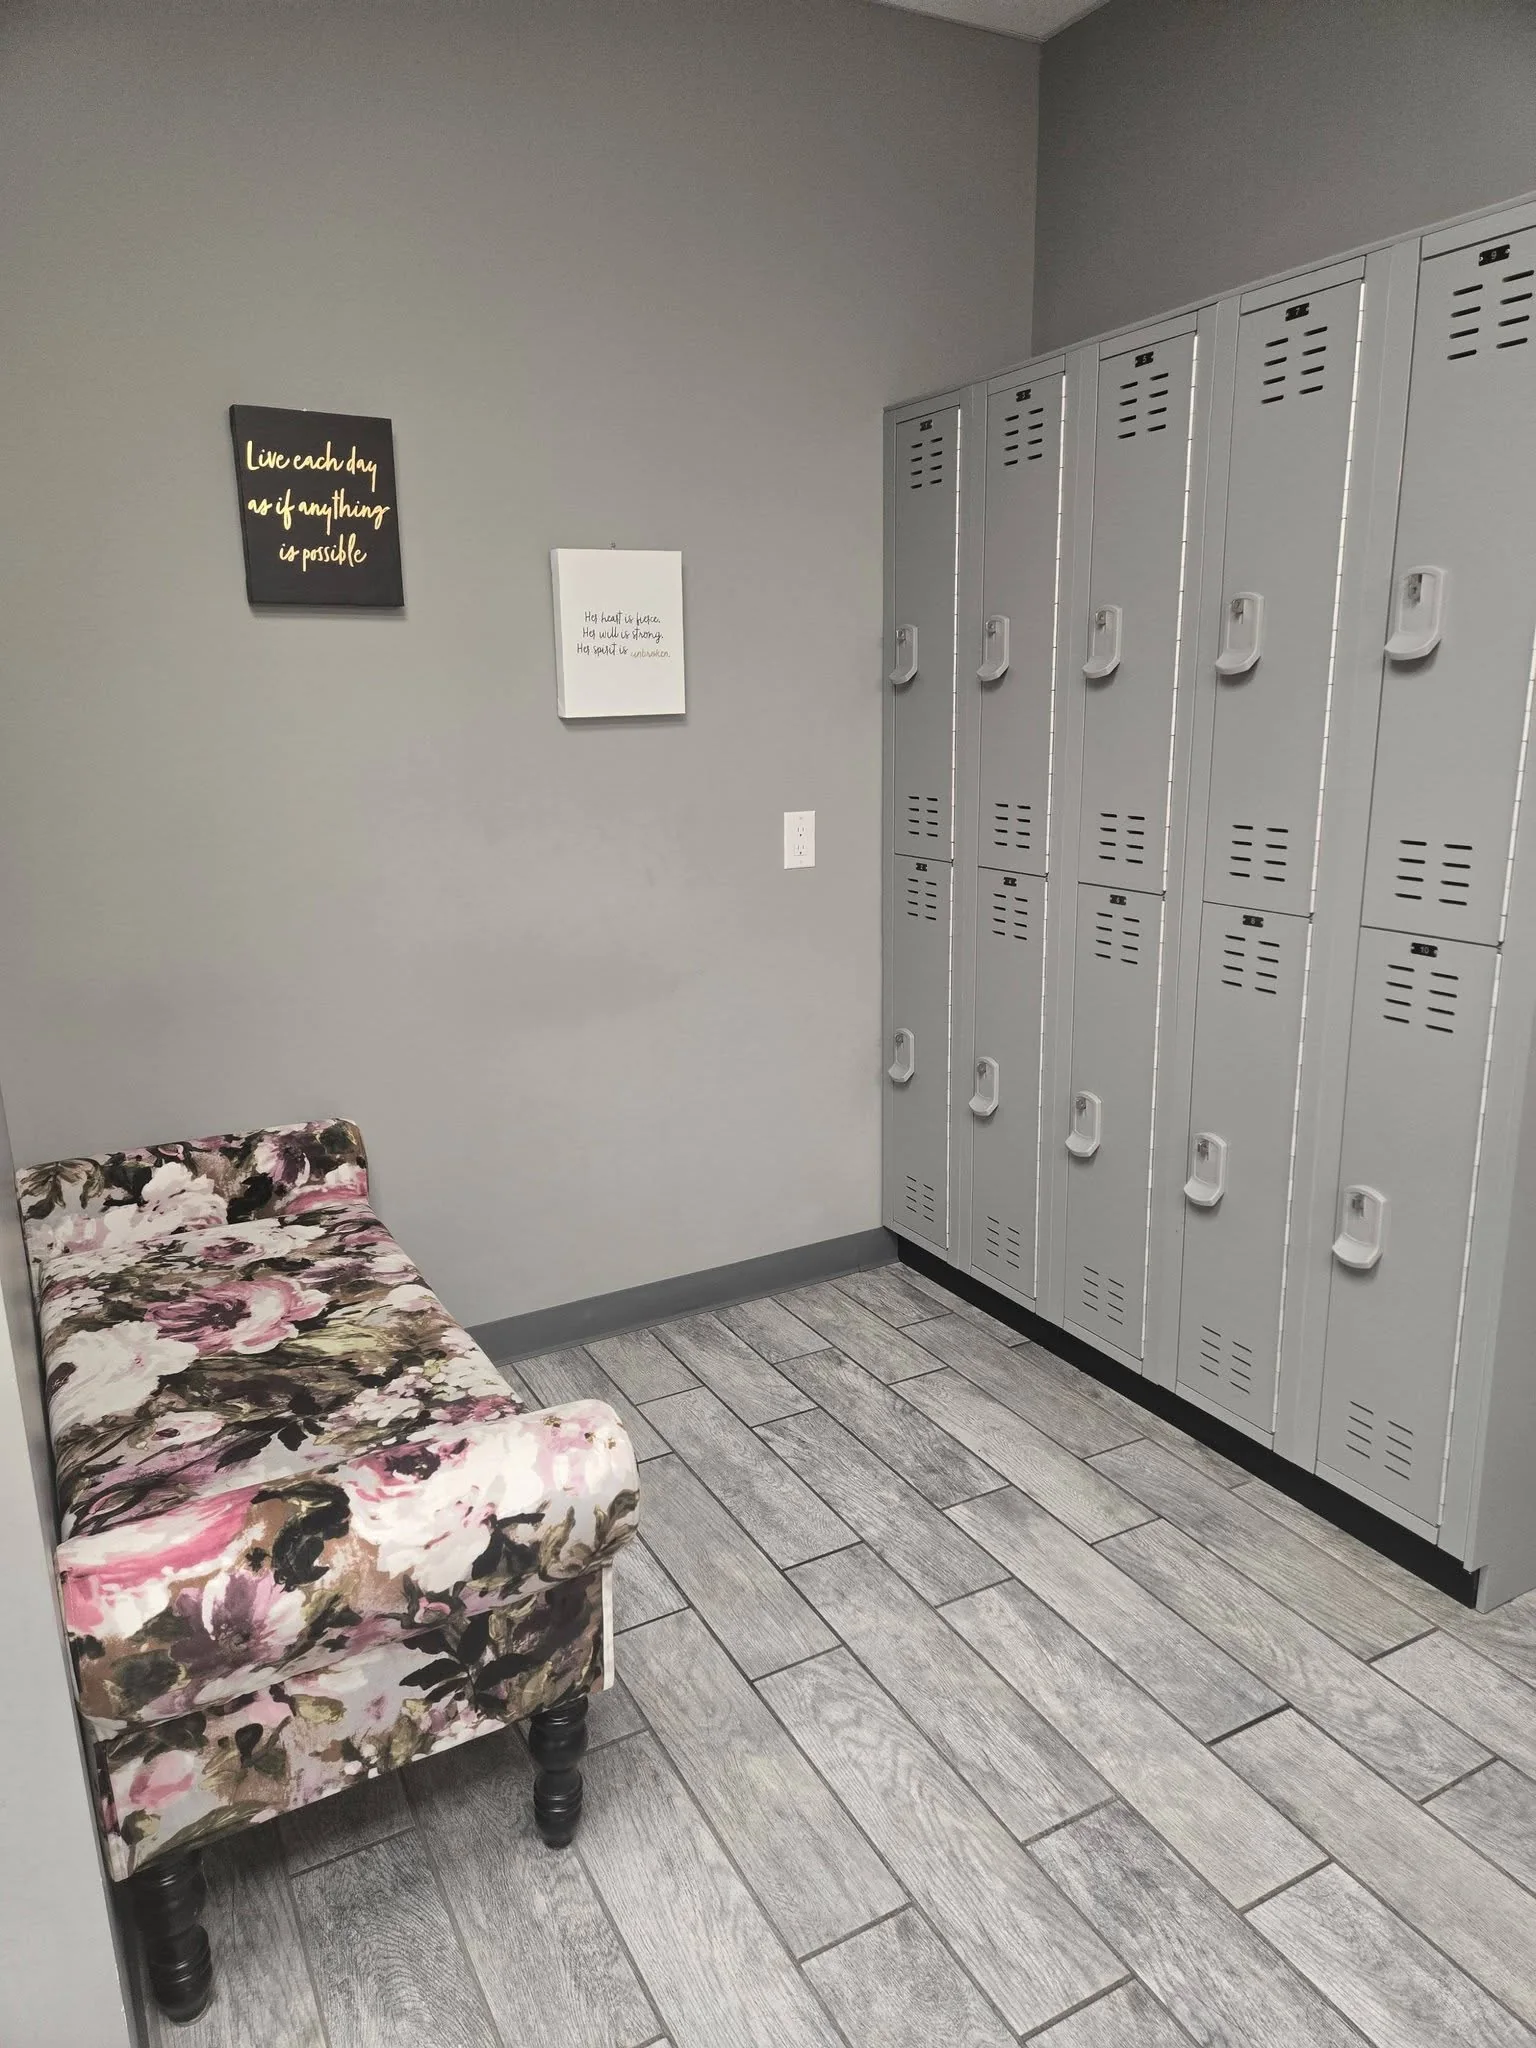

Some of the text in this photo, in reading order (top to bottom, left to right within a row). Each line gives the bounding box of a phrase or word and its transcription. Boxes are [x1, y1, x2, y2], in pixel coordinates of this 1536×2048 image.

[246, 440, 378, 493] Live each day
[247, 487, 391, 536] as if anything
[279, 532, 367, 572] is possible
[584, 610, 661, 626] Her heart is fierce.
[576, 643, 590, 655] Her
[593, 642, 617, 657] spirit
[619, 645, 628, 655] is
[582, 627, 664, 644] Her will is strong.
